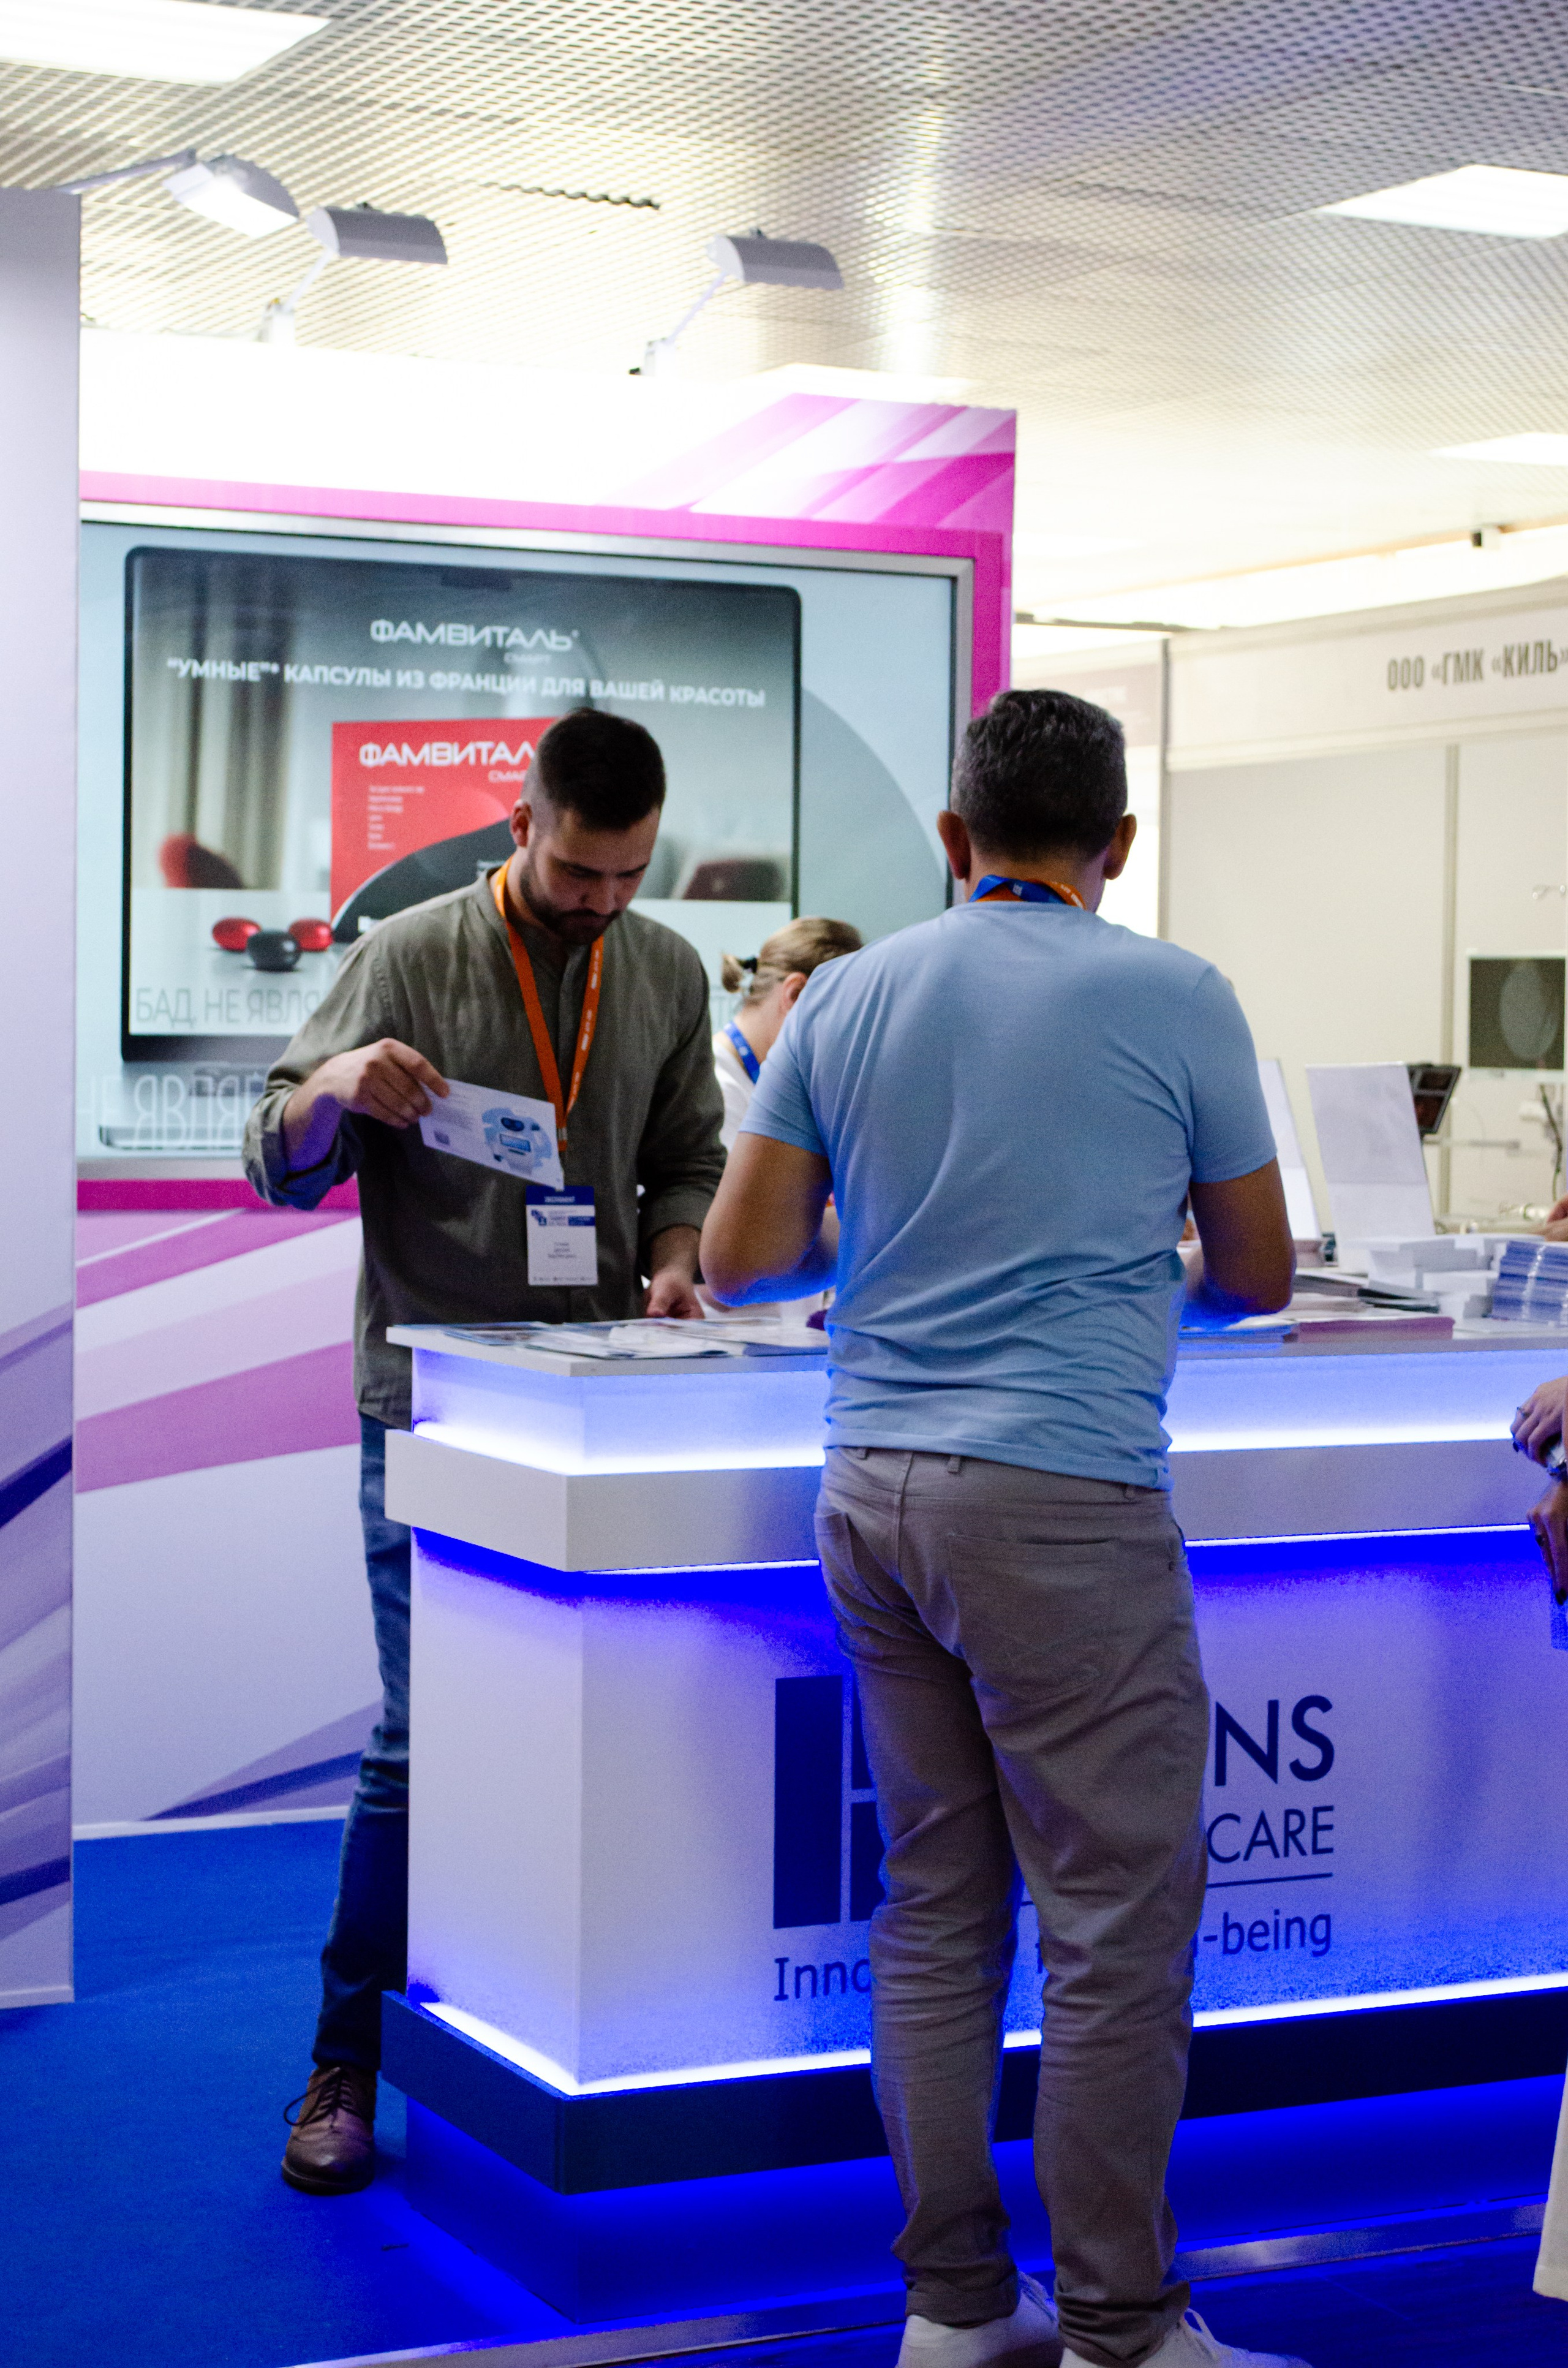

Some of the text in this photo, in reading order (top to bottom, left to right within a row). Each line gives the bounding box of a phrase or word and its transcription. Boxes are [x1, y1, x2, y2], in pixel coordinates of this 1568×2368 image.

[284, 664, 391, 687] КАПСУЛЫ
[396, 670, 424, 689] ИЗ
[429, 671, 535, 696] ФРАНЦИИ
[541, 677, 586, 698] ДЛЯ
[590, 678, 665, 702] ВАШЕЙ
[670, 686, 766, 708] КРАСОТЫ
[1387, 655, 1424, 690] ООО
[359, 741, 536, 768] ФАМВИТАЛ
[205, 988, 241, 1023] НЕ
[247, 988, 321, 1024] ЯВЛЯ
[134, 1074, 260, 1150] ЯВЛЯ
[1214, 1695, 1335, 1787] NS
[1207, 1805, 1335, 1864] CARE
[774, 1957, 870, 2002] Inno
